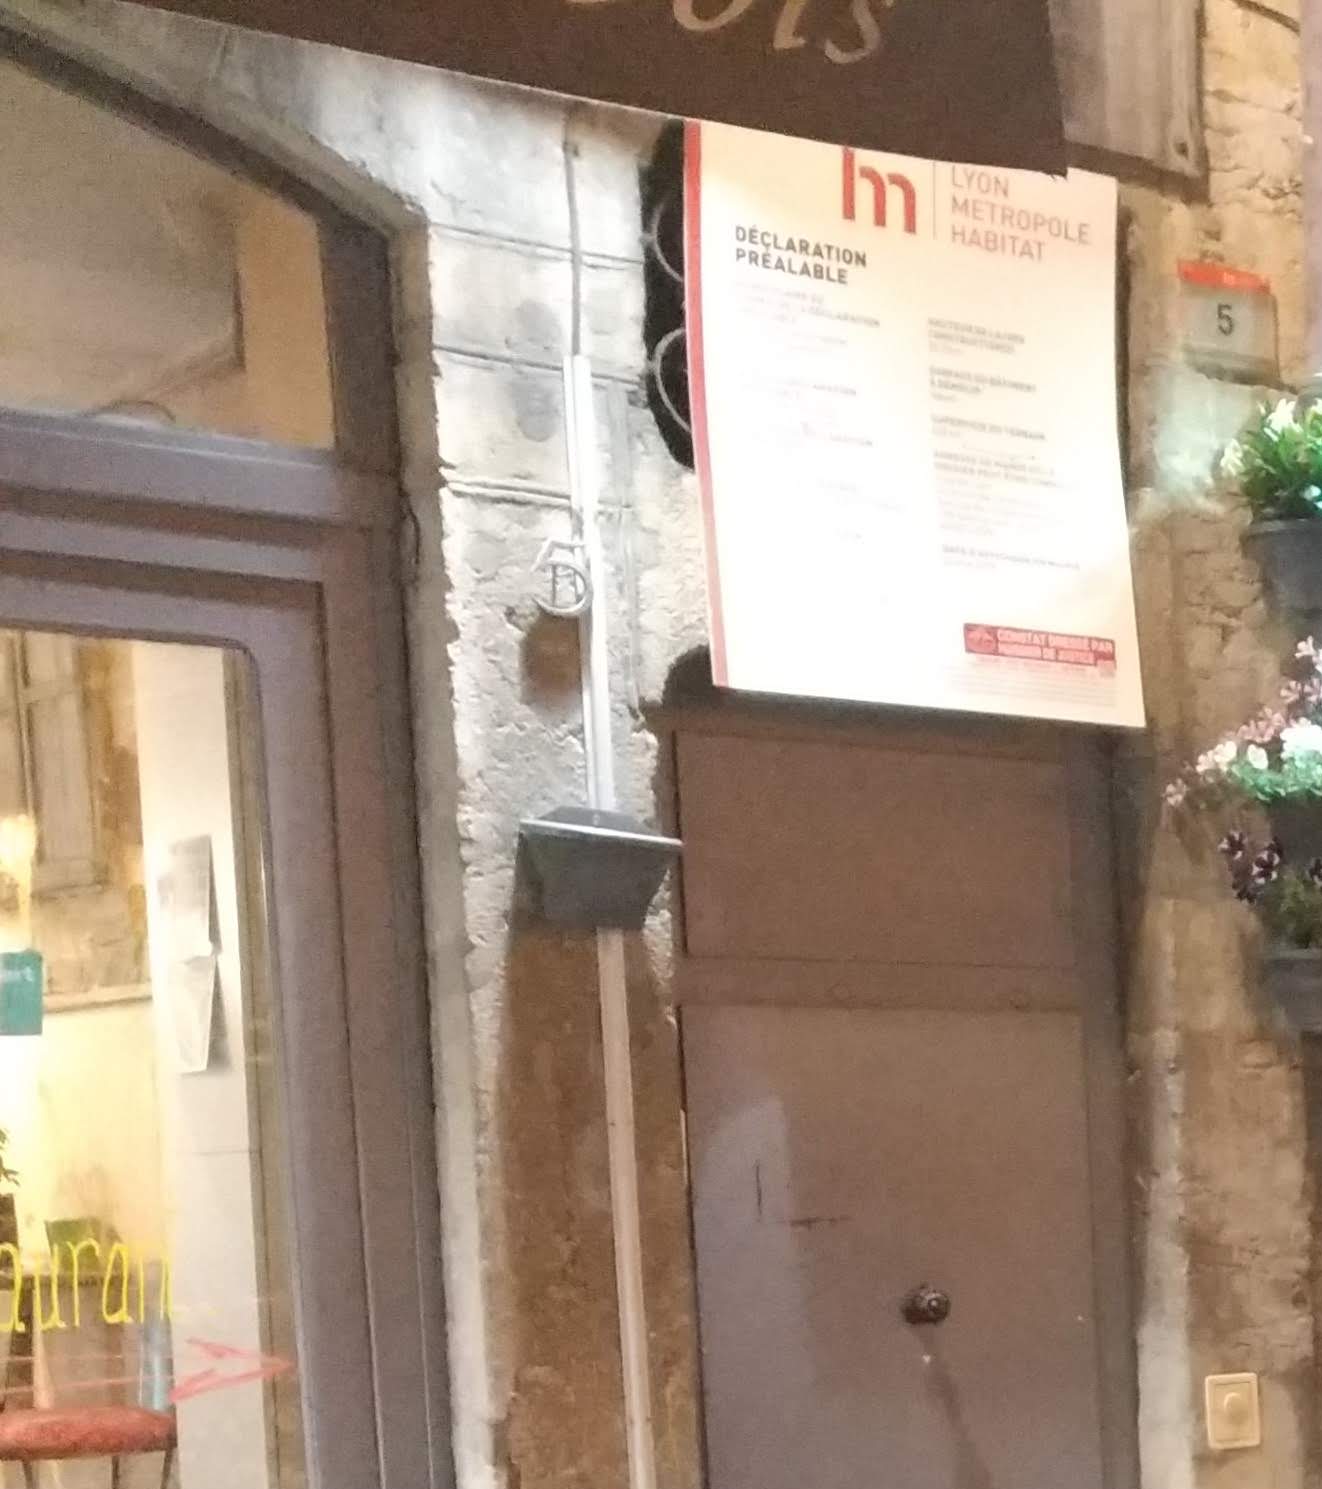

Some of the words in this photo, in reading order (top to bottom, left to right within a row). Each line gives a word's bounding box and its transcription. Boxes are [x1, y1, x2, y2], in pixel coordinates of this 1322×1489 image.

[951, 165, 1010, 198] LYON
[951, 196, 1091, 246] METROPOLE
[735, 225, 867, 268] DÉCLARATION
[951, 224, 1045, 263] HABITAT
[735, 249, 848, 285] PRÉALABLE
[1217, 303, 1233, 335] 5
